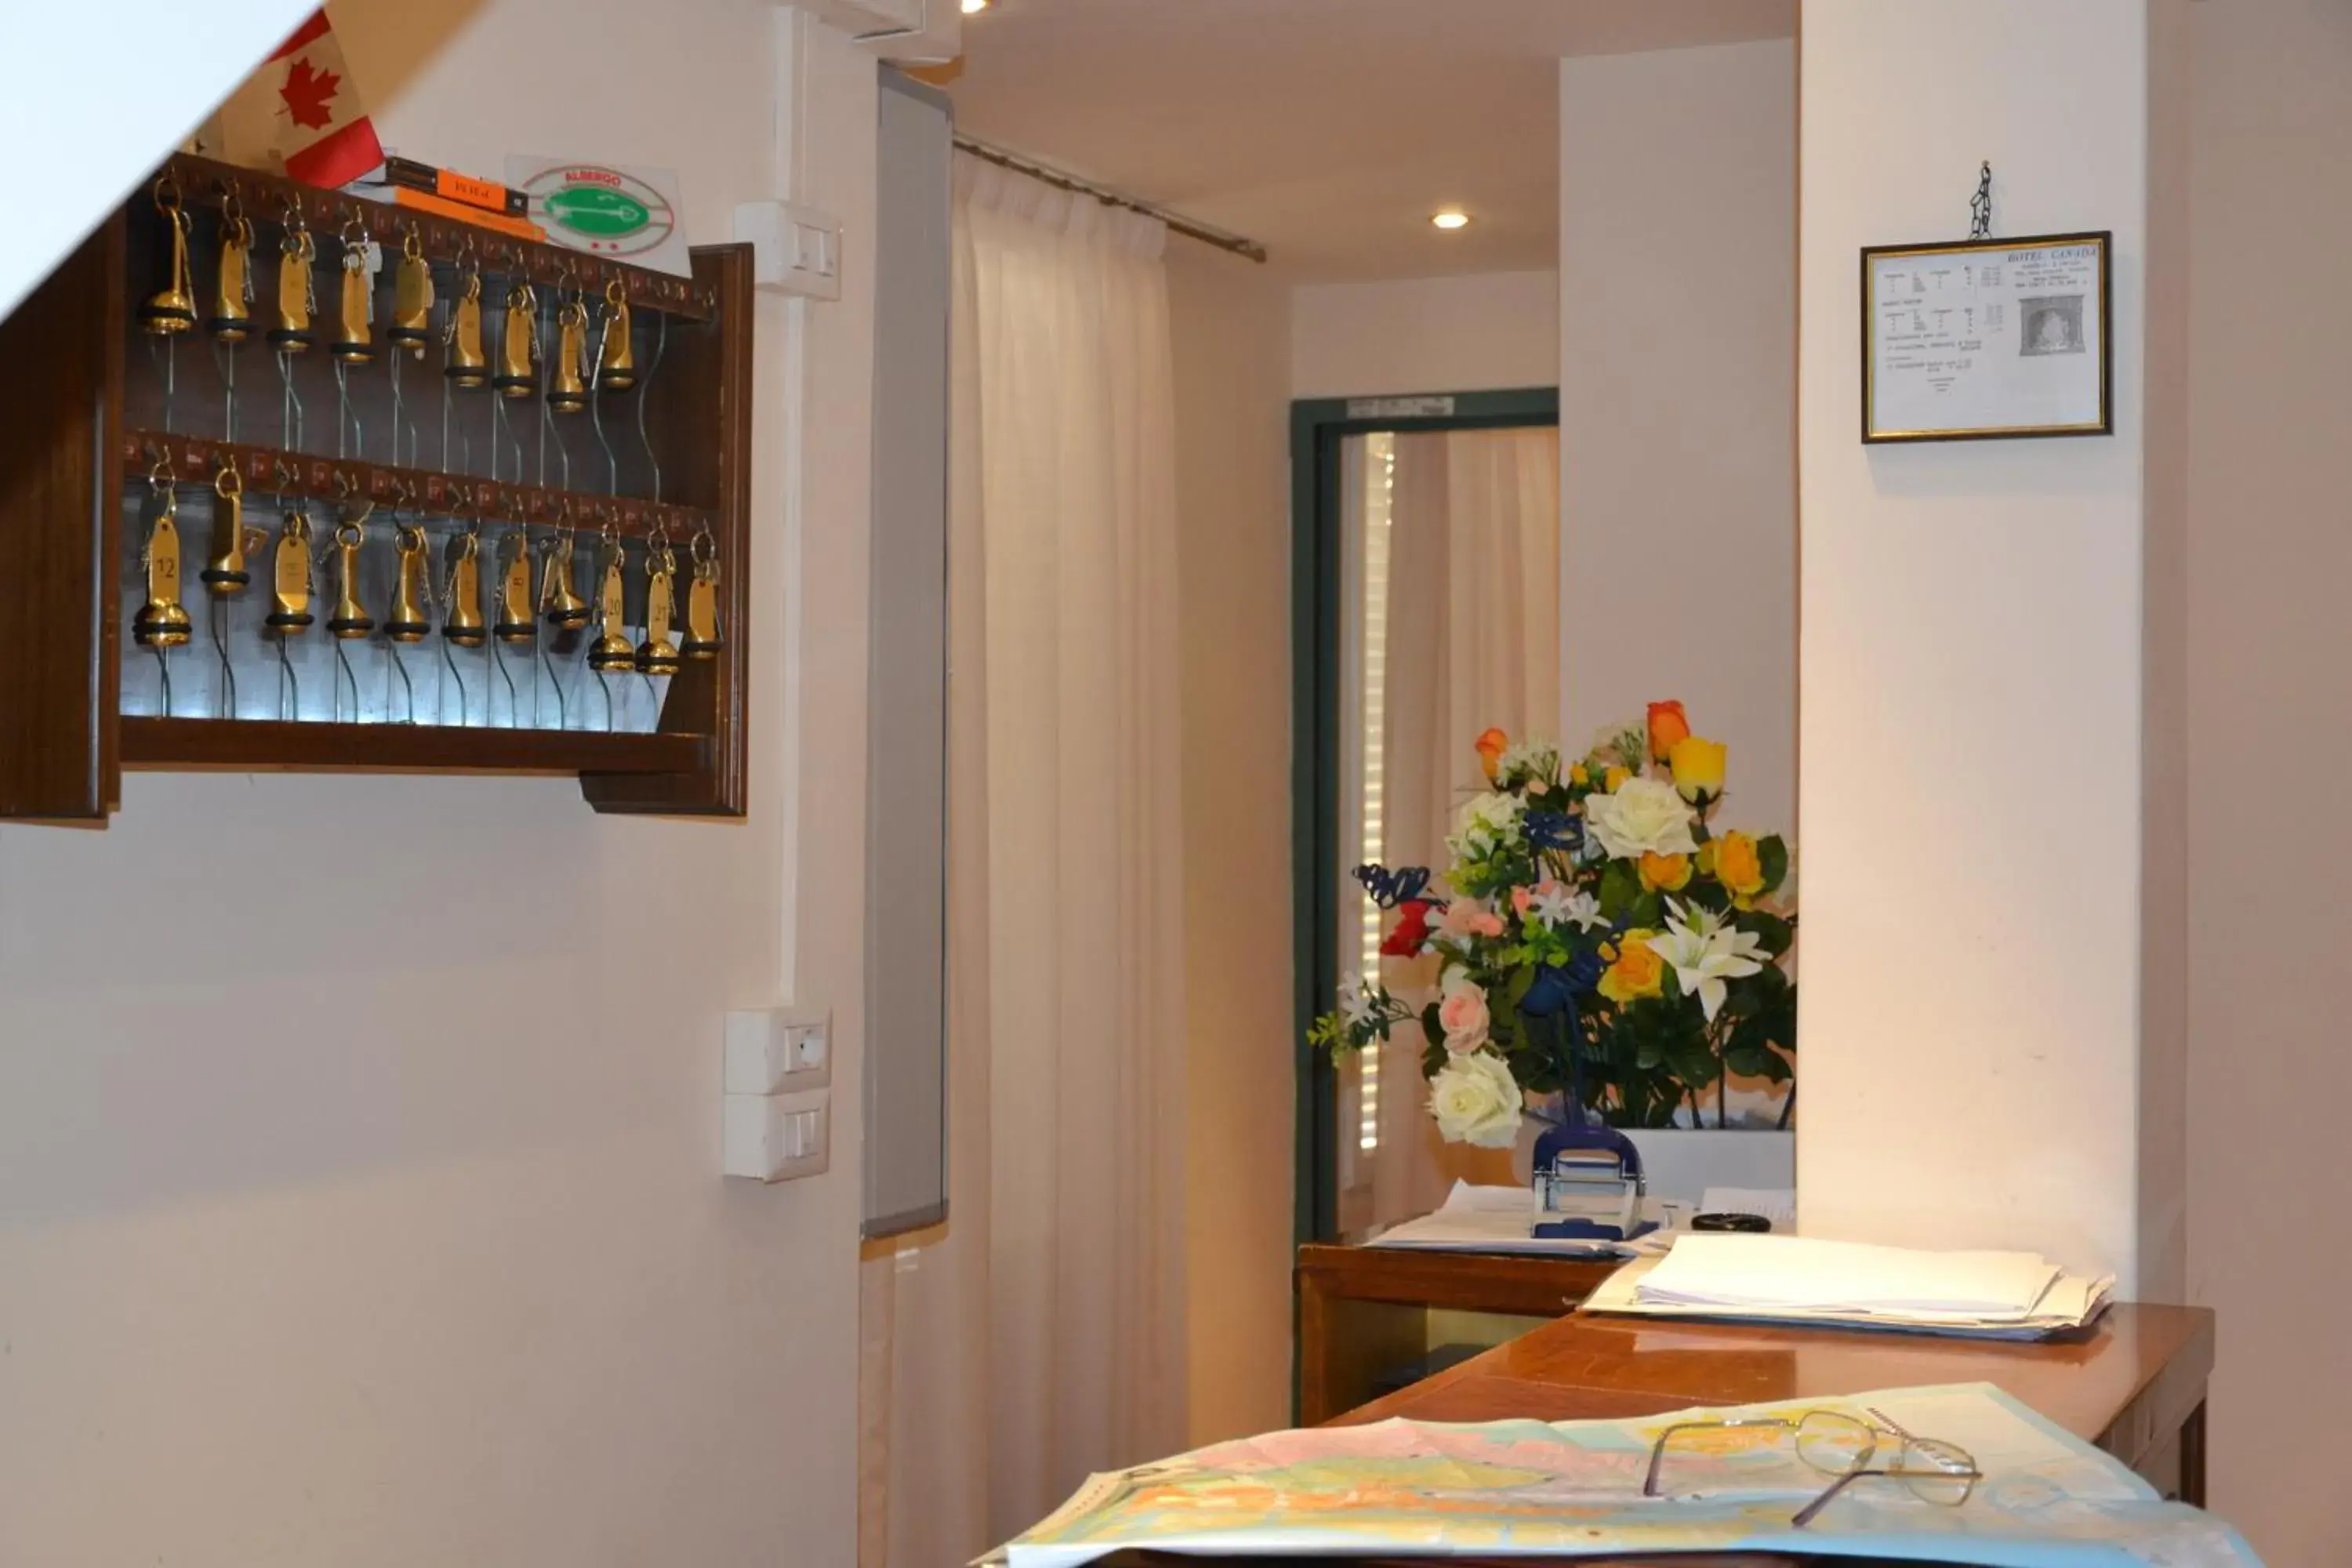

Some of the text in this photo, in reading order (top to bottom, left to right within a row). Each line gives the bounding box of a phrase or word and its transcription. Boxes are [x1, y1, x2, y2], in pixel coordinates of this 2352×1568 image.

[565, 170, 622, 187] ALBERGO
[2008, 246, 2097, 263] HOTEL CANADA
[156, 557, 175, 578] 12
